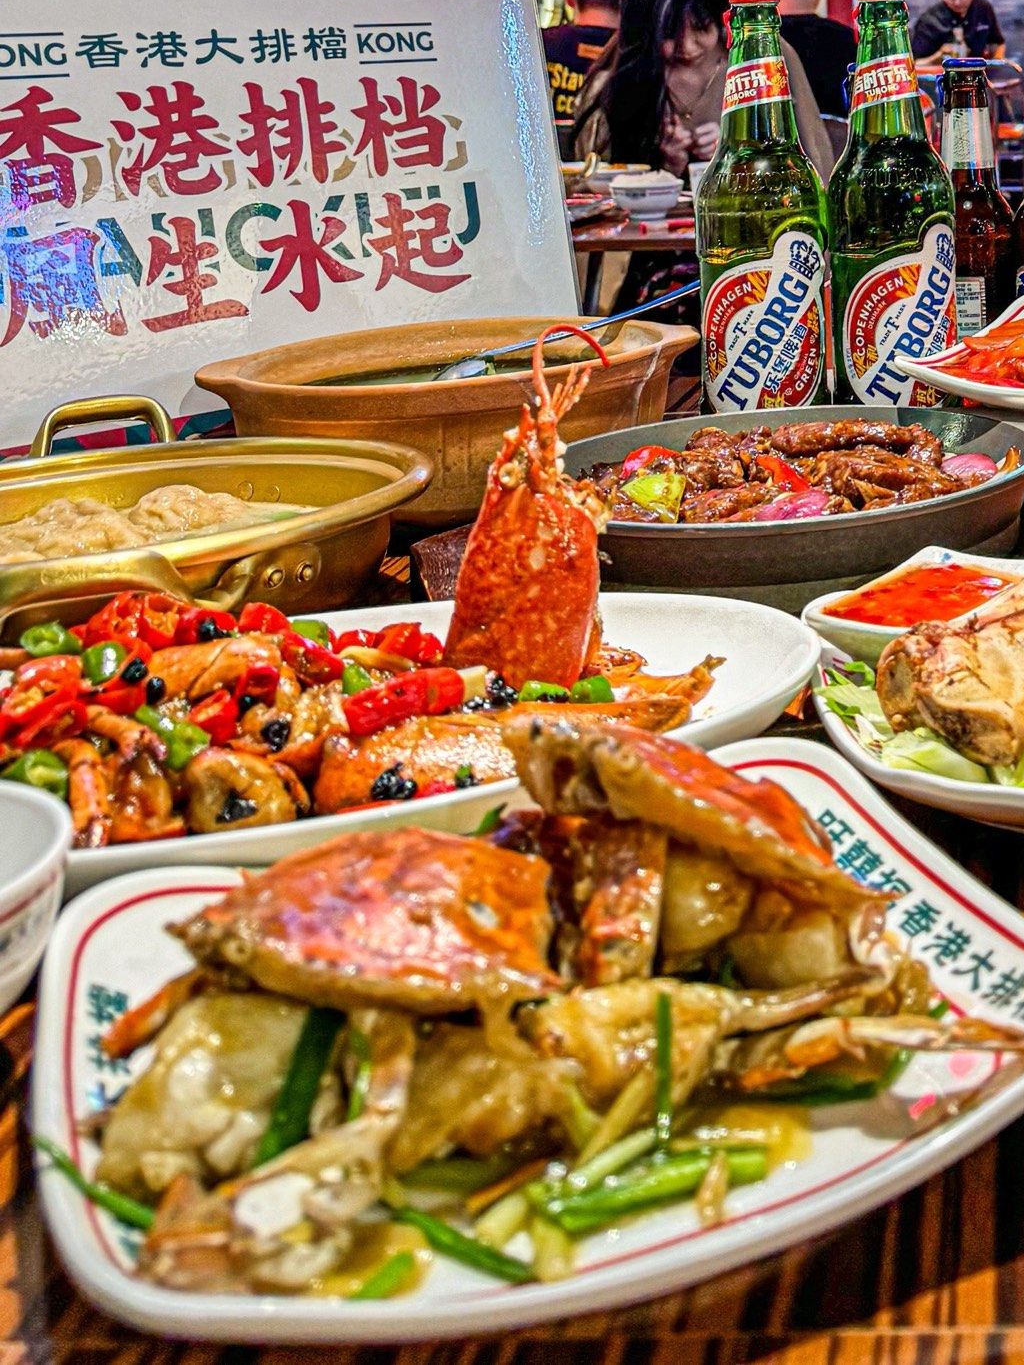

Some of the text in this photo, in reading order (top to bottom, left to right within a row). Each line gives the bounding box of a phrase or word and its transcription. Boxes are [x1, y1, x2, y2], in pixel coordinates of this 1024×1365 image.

[74, 26, 349, 70] 香港大排檔
[357, 31, 435, 55] KONG
[0, 75, 448, 209] 香港排档
[708, 280, 752, 362] COPENHAGEN
[716, 272, 810, 411] TUBORG
[855, 276, 904, 357] COPENHAGEN
[763, 322, 808, 394] 乐堡啤酒
[794, 346, 817, 392] GREEN
